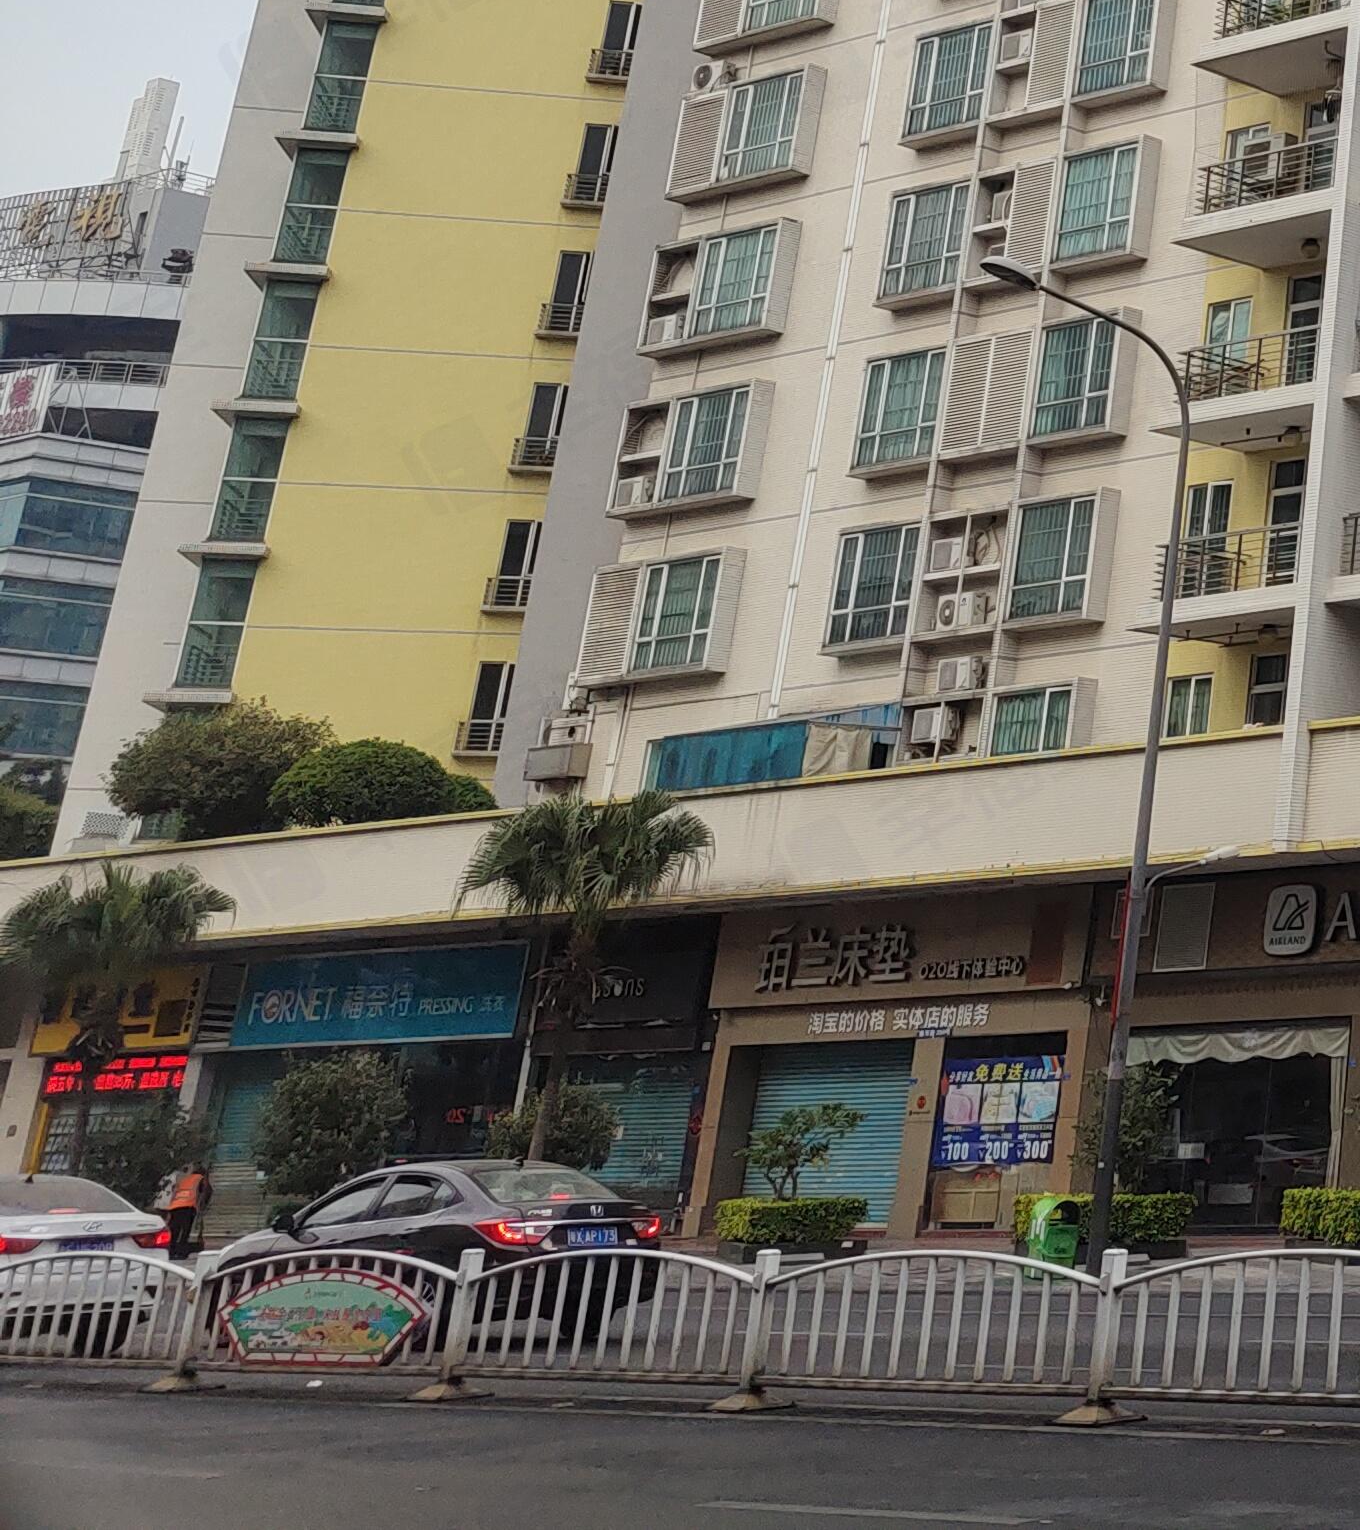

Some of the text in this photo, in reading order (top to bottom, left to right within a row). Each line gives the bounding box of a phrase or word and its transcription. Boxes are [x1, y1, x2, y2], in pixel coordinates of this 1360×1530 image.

[1269, 936, 1306, 947] AIRLAND
[755, 924, 909, 992] 珀兰床垫
[248, 986, 337, 1025] FORNET
[341, 981, 413, 1019] 福奈特
[418, 996, 473, 1015] PRESSING
[807, 1003, 990, 1035] 淘宝的价格 实体店的服务
[975, 1062, 1024, 1081] 免费送
